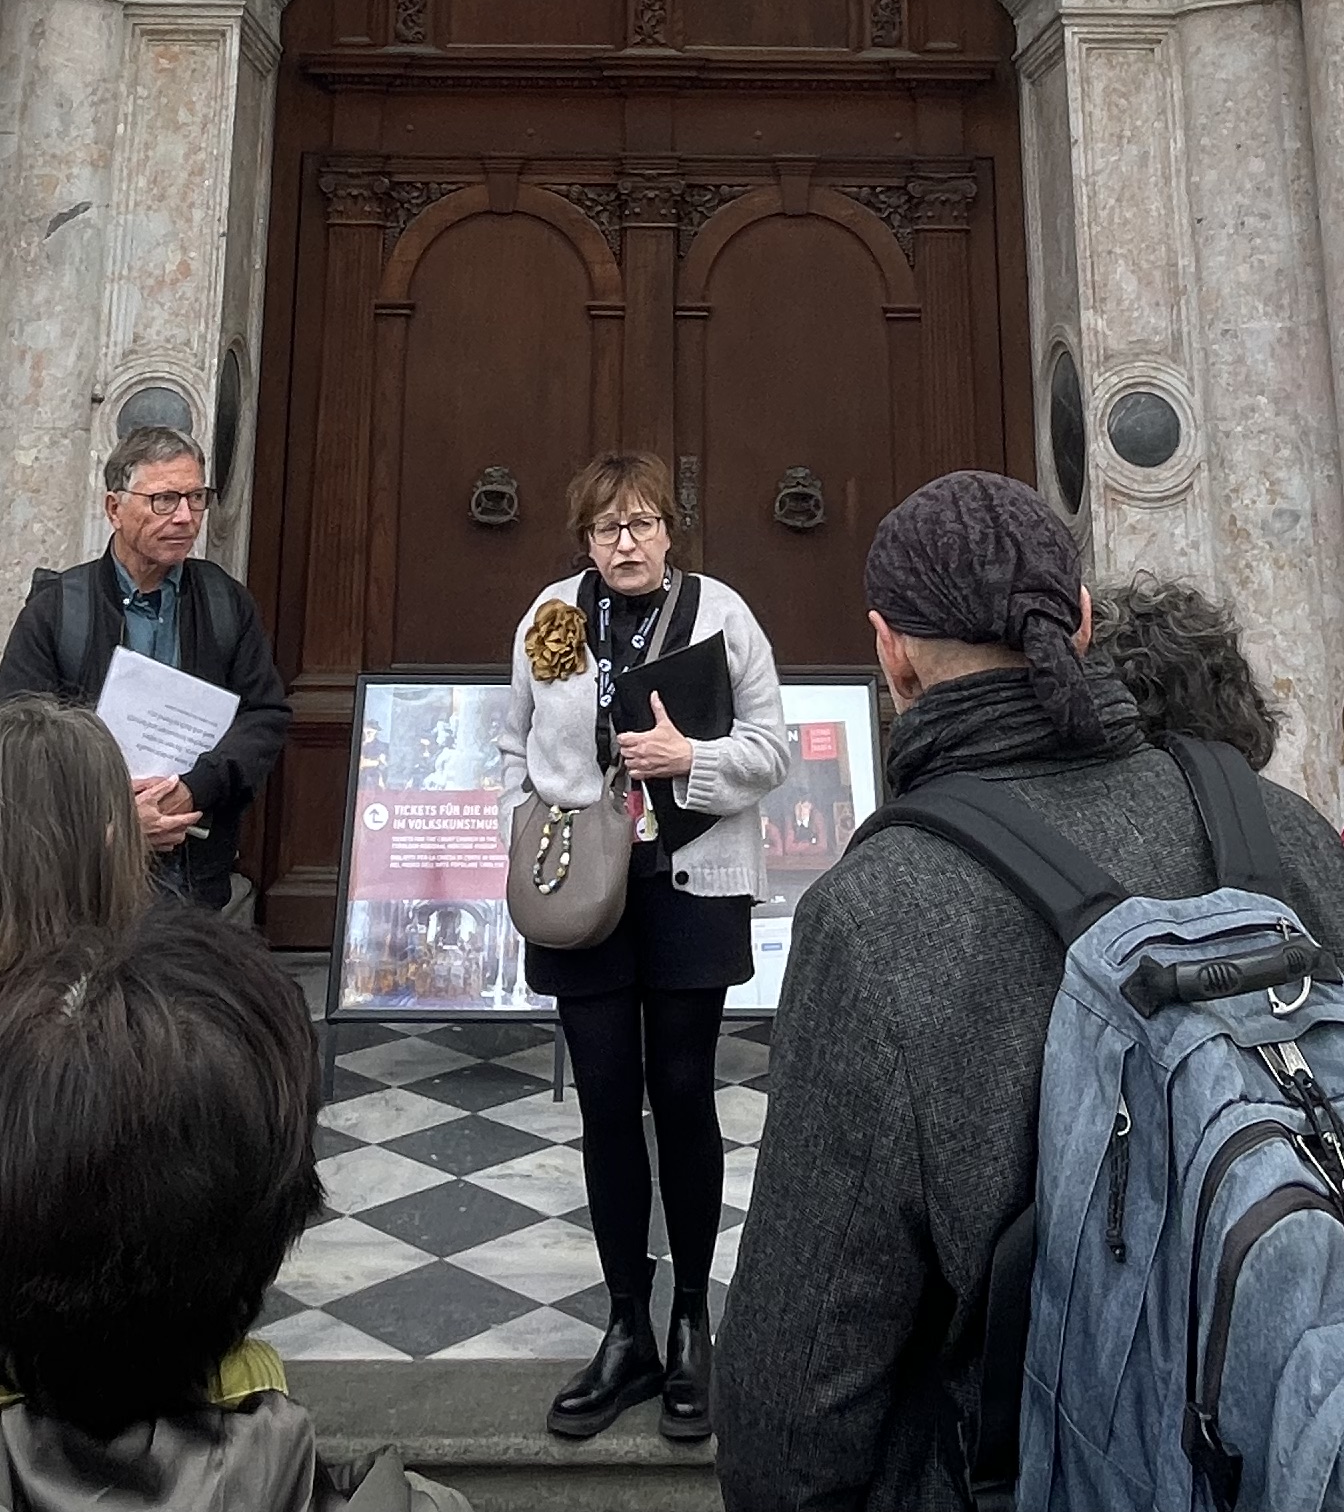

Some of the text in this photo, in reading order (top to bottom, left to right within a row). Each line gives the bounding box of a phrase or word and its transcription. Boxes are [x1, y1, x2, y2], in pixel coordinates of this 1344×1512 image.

[393, 804, 437, 816] TICKETS
[439, 802, 460, 816] FÜR
[462, 805, 481, 816] DIE
[408, 818, 499, 830] VOLKSKUNSTMUS
